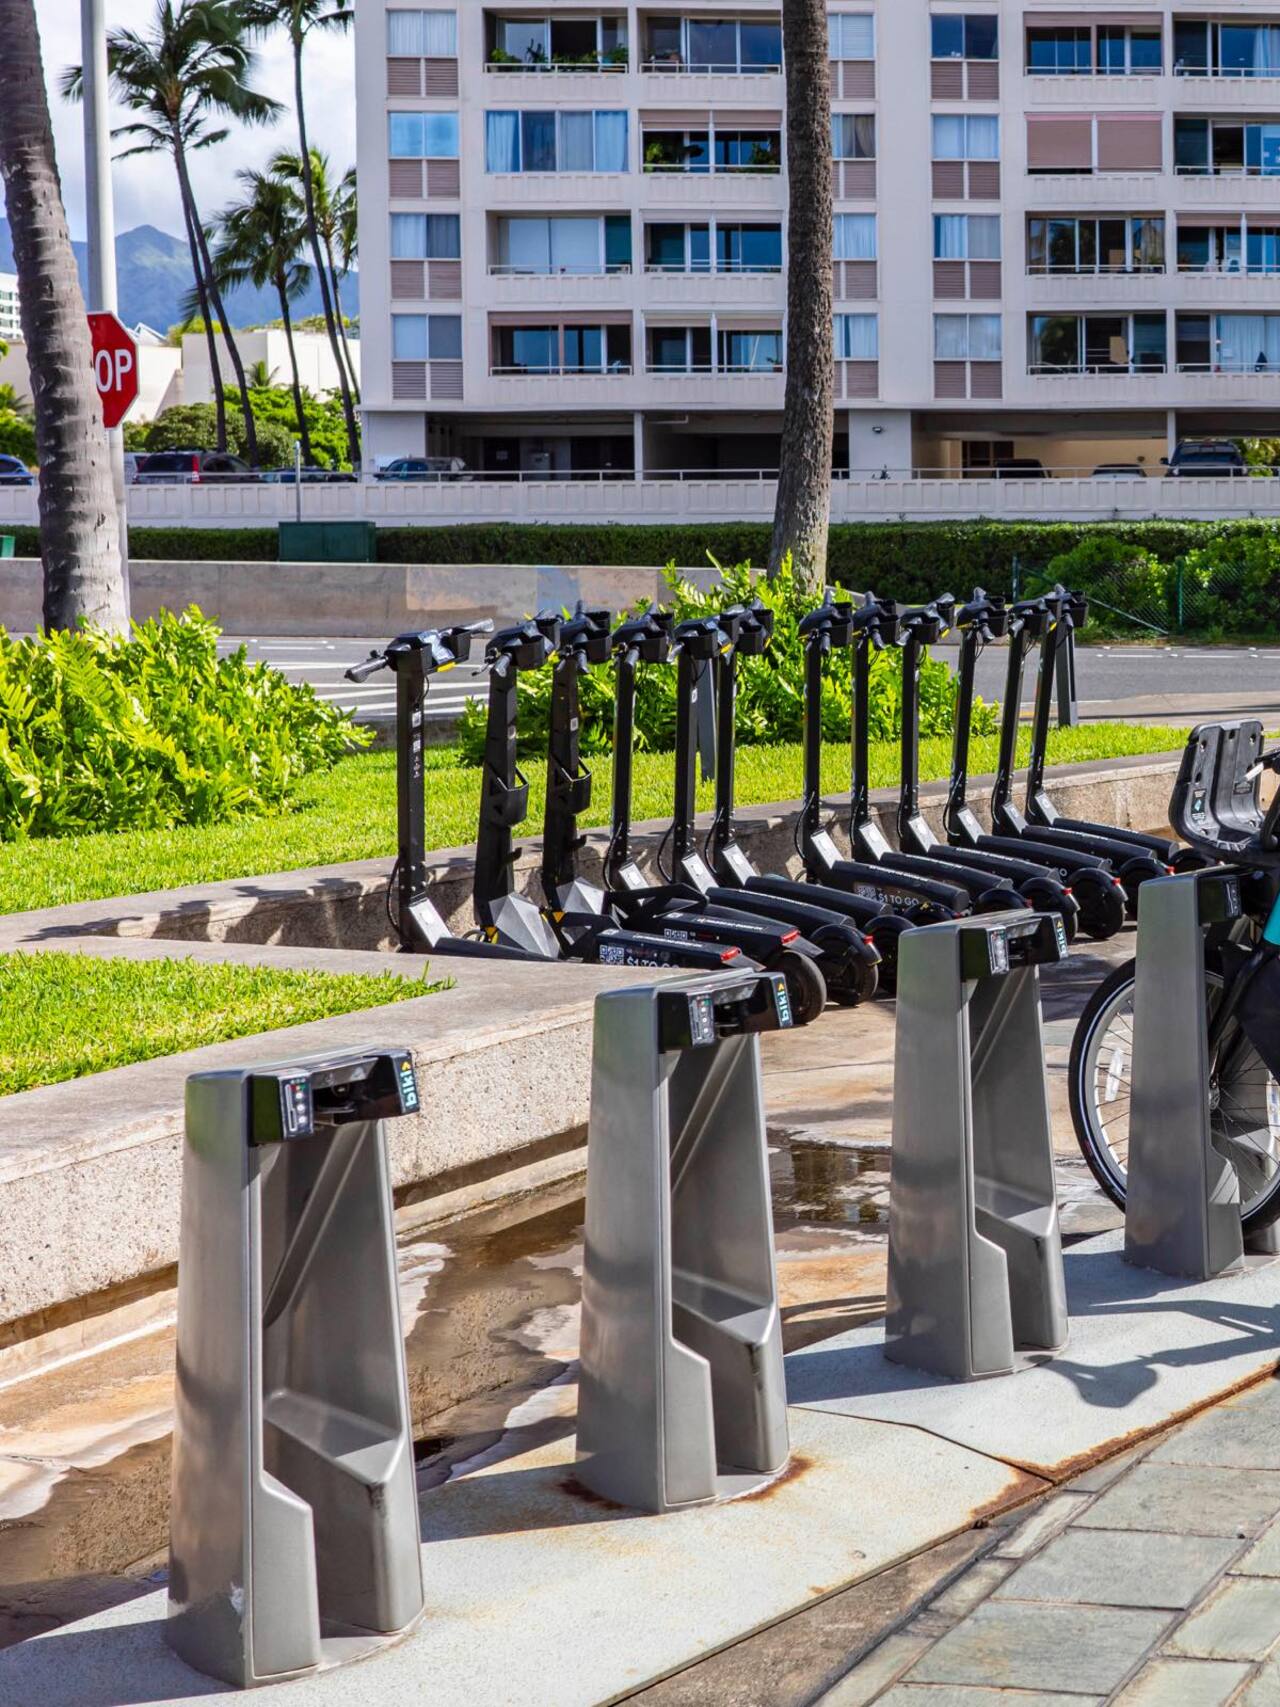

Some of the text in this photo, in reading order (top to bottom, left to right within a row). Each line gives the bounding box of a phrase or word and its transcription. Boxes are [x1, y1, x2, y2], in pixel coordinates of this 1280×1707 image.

[94, 349, 133, 393] OP
[889, 895, 902, 905] TO
[905, 897, 919, 906] GO
[777, 990, 790, 1022] biki
[400, 1070, 417, 1107] biki
